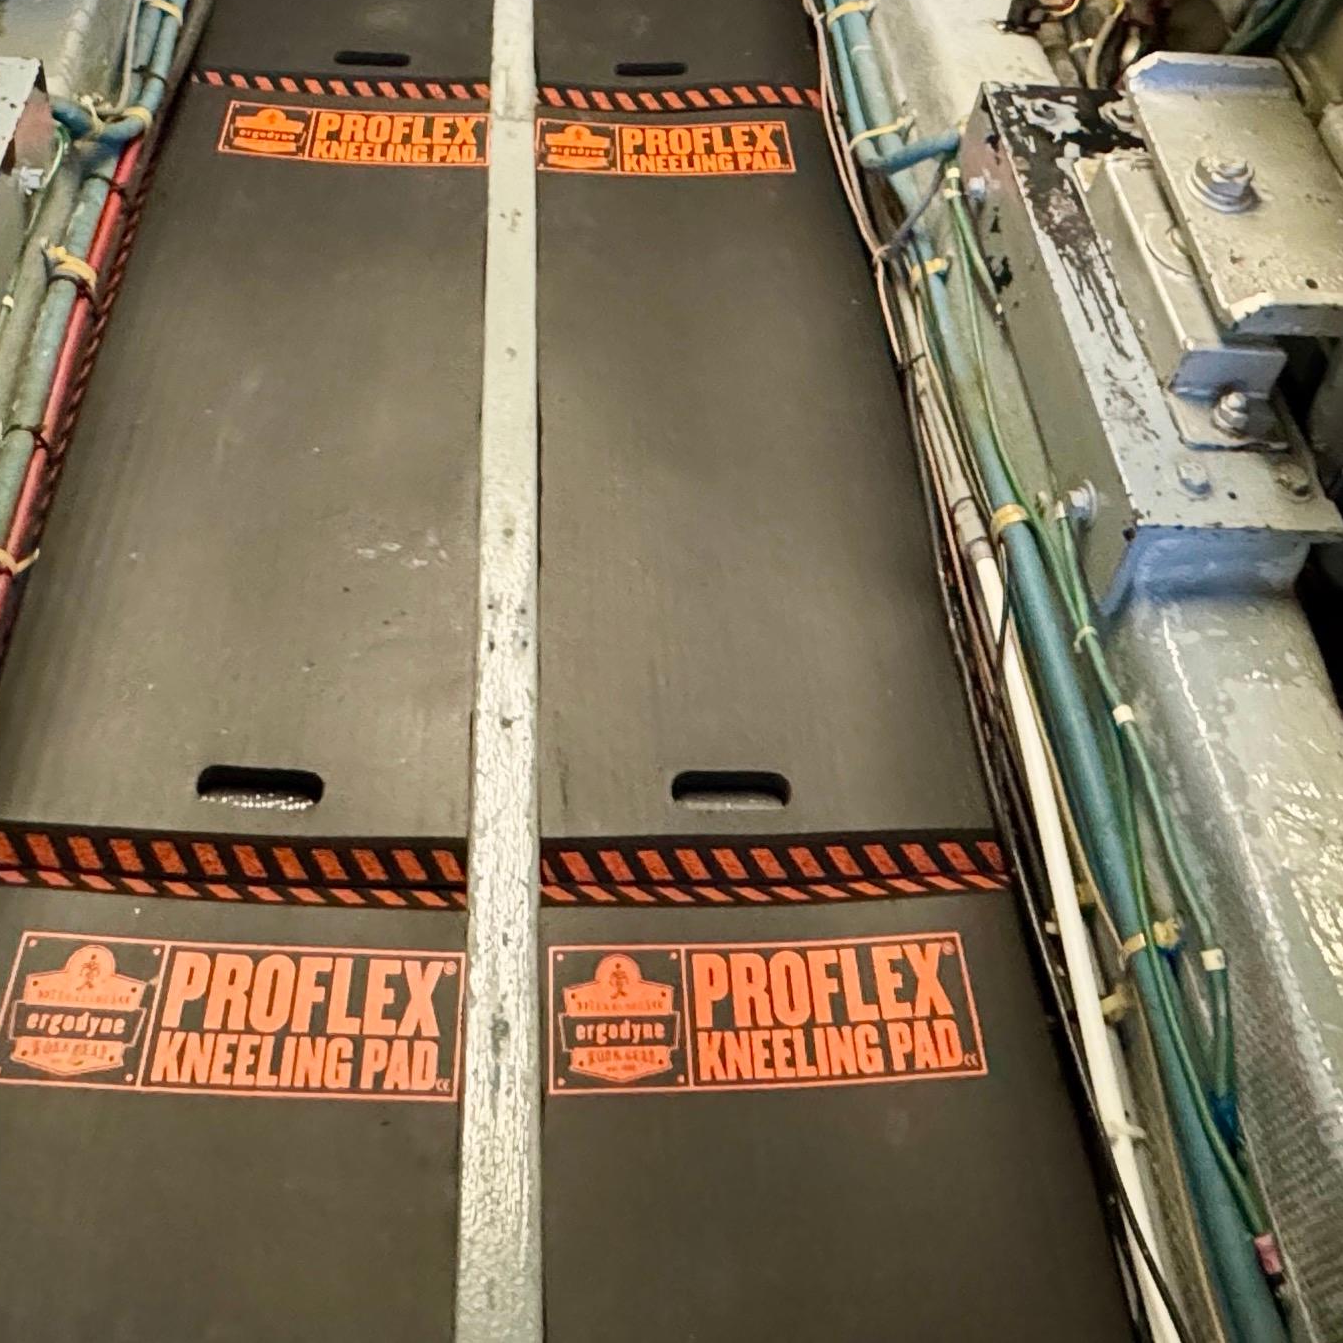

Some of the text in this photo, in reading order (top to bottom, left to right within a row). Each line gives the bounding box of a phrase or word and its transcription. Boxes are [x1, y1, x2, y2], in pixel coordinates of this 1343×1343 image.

[316, 112, 479, 145] PROFLEX
[621, 124, 779, 155] PROFLEX
[312, 139, 477, 163] KNEELING PAD
[623, 151, 782, 173] KNEELING PAD
[161, 951, 445, 1037] PROFLEX
[691, 942, 955, 1028] PROFLEX
[26, 1011, 126, 1038] ergodyne
[575, 1019, 665, 1045] ergodyne
[150, 1030, 354, 1089] KNEELING
[360, 1038, 439, 1091] PAD
[697, 1023, 884, 1081] KNEELING
[887, 1018, 964, 1071] PAD
